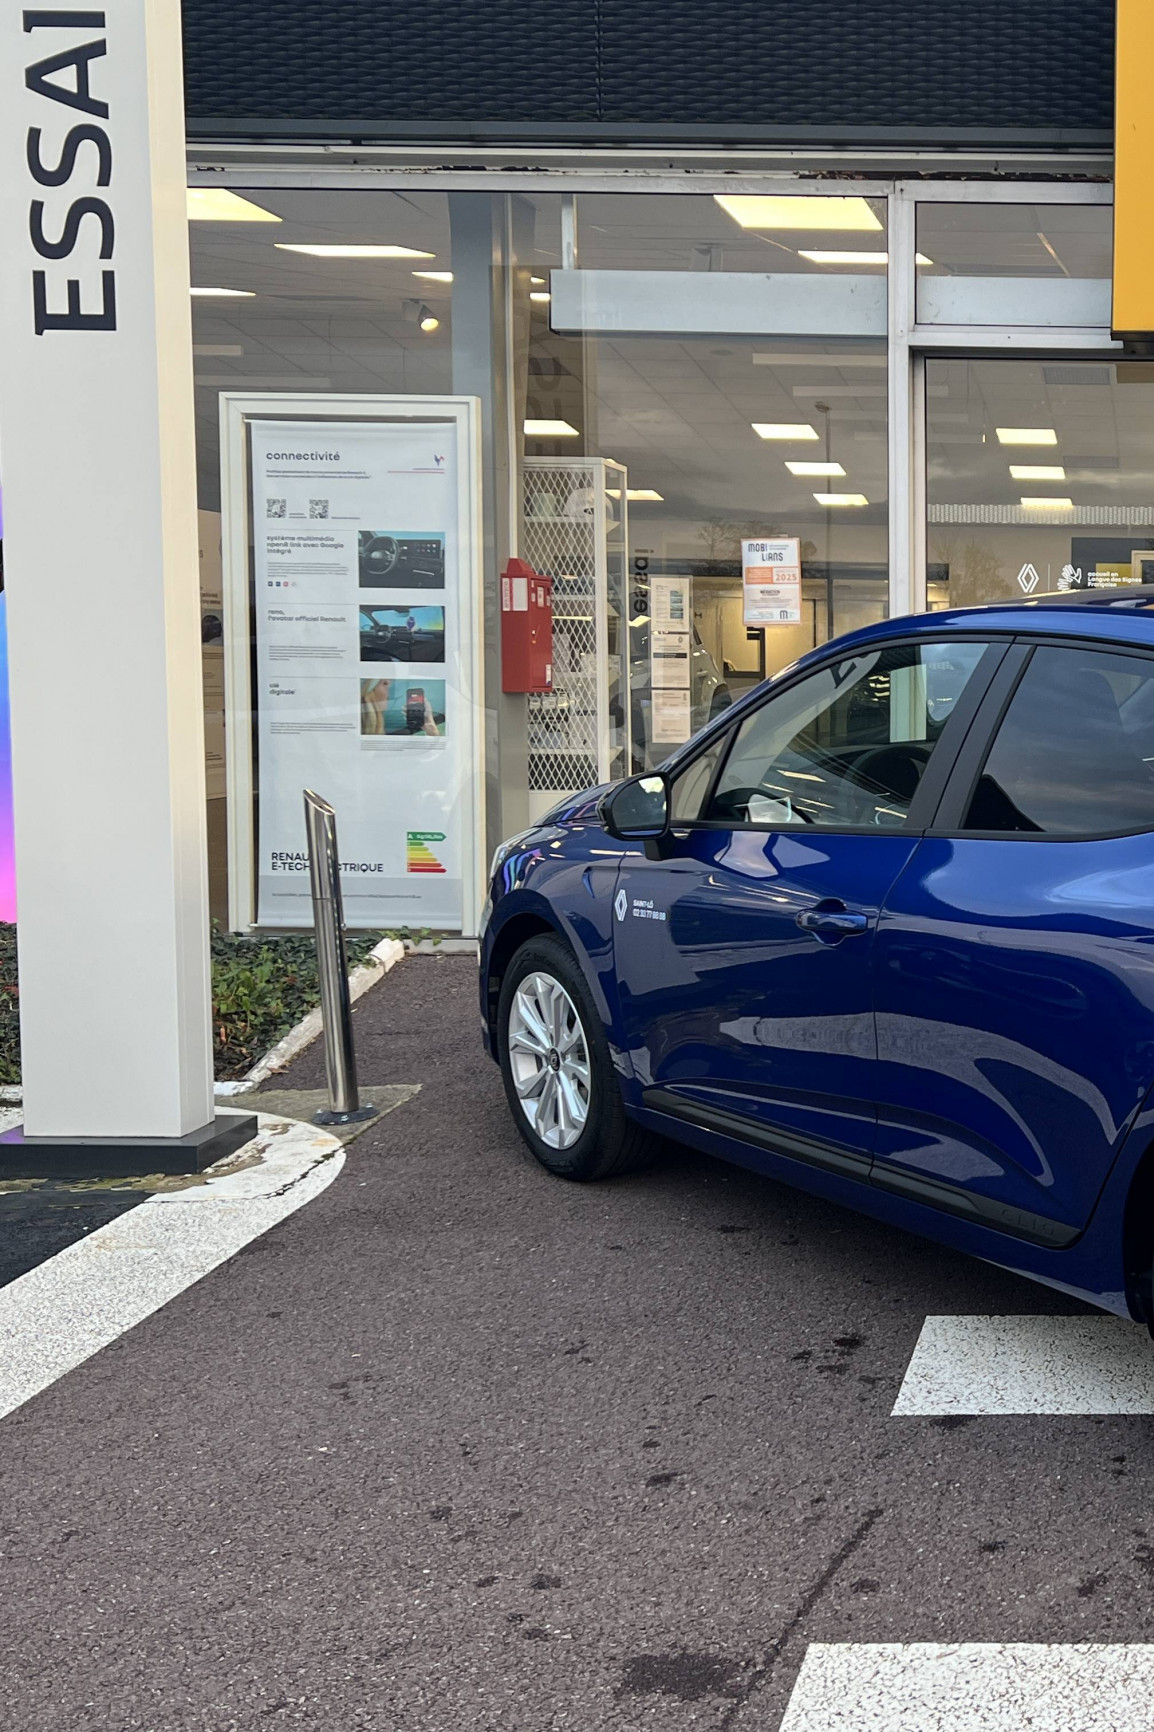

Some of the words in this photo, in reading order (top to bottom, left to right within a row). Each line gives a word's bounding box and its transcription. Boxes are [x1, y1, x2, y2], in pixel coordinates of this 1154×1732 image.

[23, 10, 117, 335] ESSAI
[266, 451, 340, 461] connectivité
[272, 852, 310, 861] RENAU
